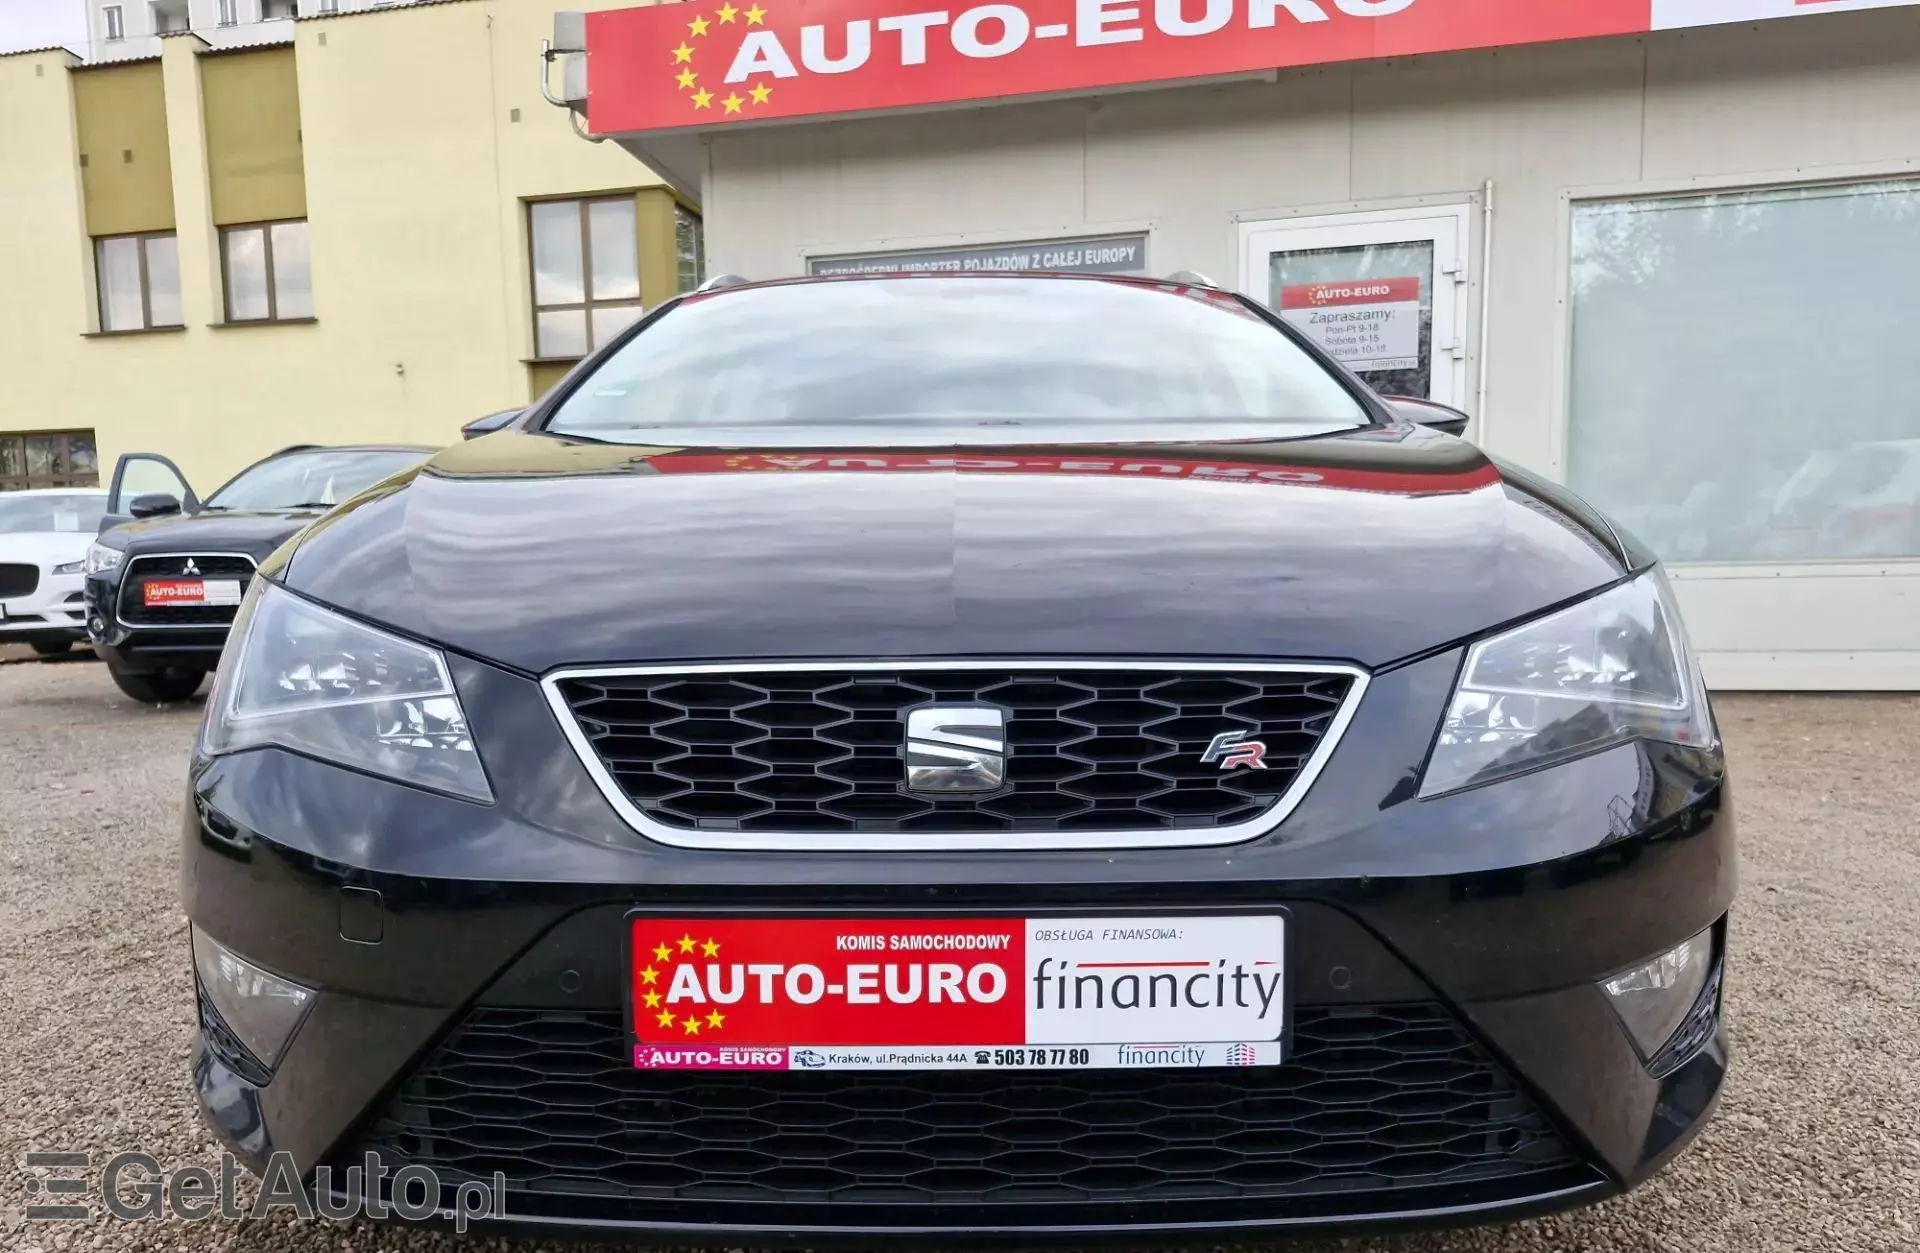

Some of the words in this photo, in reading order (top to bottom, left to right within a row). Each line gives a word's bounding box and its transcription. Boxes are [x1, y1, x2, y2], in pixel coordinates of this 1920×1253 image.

[964, 253, 1029, 271] POJAZDÓW
[1032, 253, 1041, 269] Z
[1043, 251, 1082, 268] CAŁEJ
[1085, 246, 1136, 264] EUROPY
[1316, 285, 1390, 299] AUTO-EURO
[150, 587, 203, 596] AUTO-EURO
[1200, 730, 1268, 770] FR
[836, 935, 886, 950] KOMIS
[890, 934, 1011, 950] SAMOCHODOWY
[1035, 929, 1094, 942] OBSŁUGA
[1102, 928, 1184, 941] FINANSOWA:
[666, 963, 1007, 1004] AUTO-EURO
[1033, 957, 1281, 1019] financity
[650, 1051, 782, 1065] AUTO-EURO
[829, 1052, 873, 1065] Kraków,
[876, 1052, 944, 1066] ul.Prądnicka
[946, 1052, 968, 1063] 44A
[994, 1049, 1025, 1065] 503
[1029, 1049, 1047, 1065] 78
[1050, 1049, 1067, 1065] 77
[1068, 1049, 1089, 1065] 80
[1117, 1044, 1205, 1067] financity
